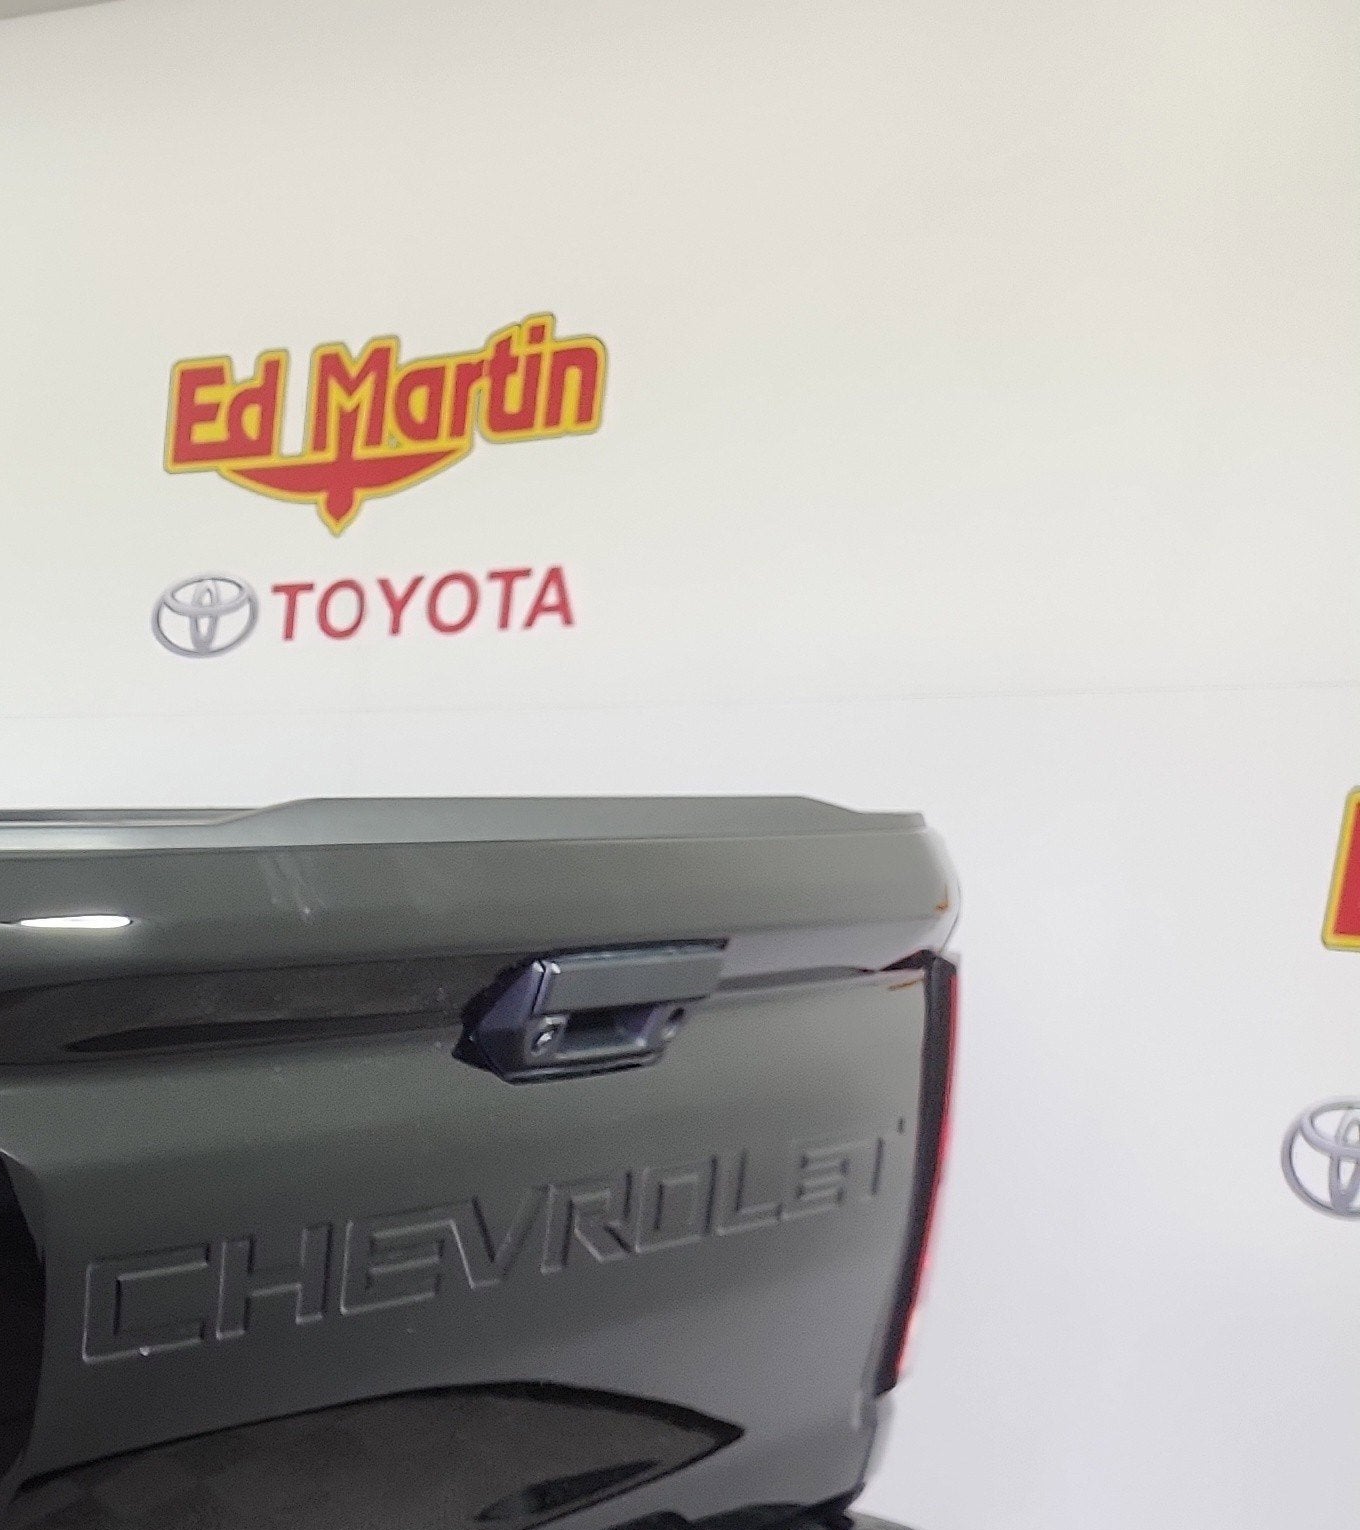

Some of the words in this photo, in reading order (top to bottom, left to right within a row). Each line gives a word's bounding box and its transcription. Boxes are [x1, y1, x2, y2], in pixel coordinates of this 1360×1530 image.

[164, 347, 290, 474] Ed
[304, 312, 607, 462] Martin
[271, 563, 576, 642] TOYOTA
[81, 1116, 907, 1363] CHEVROLET
